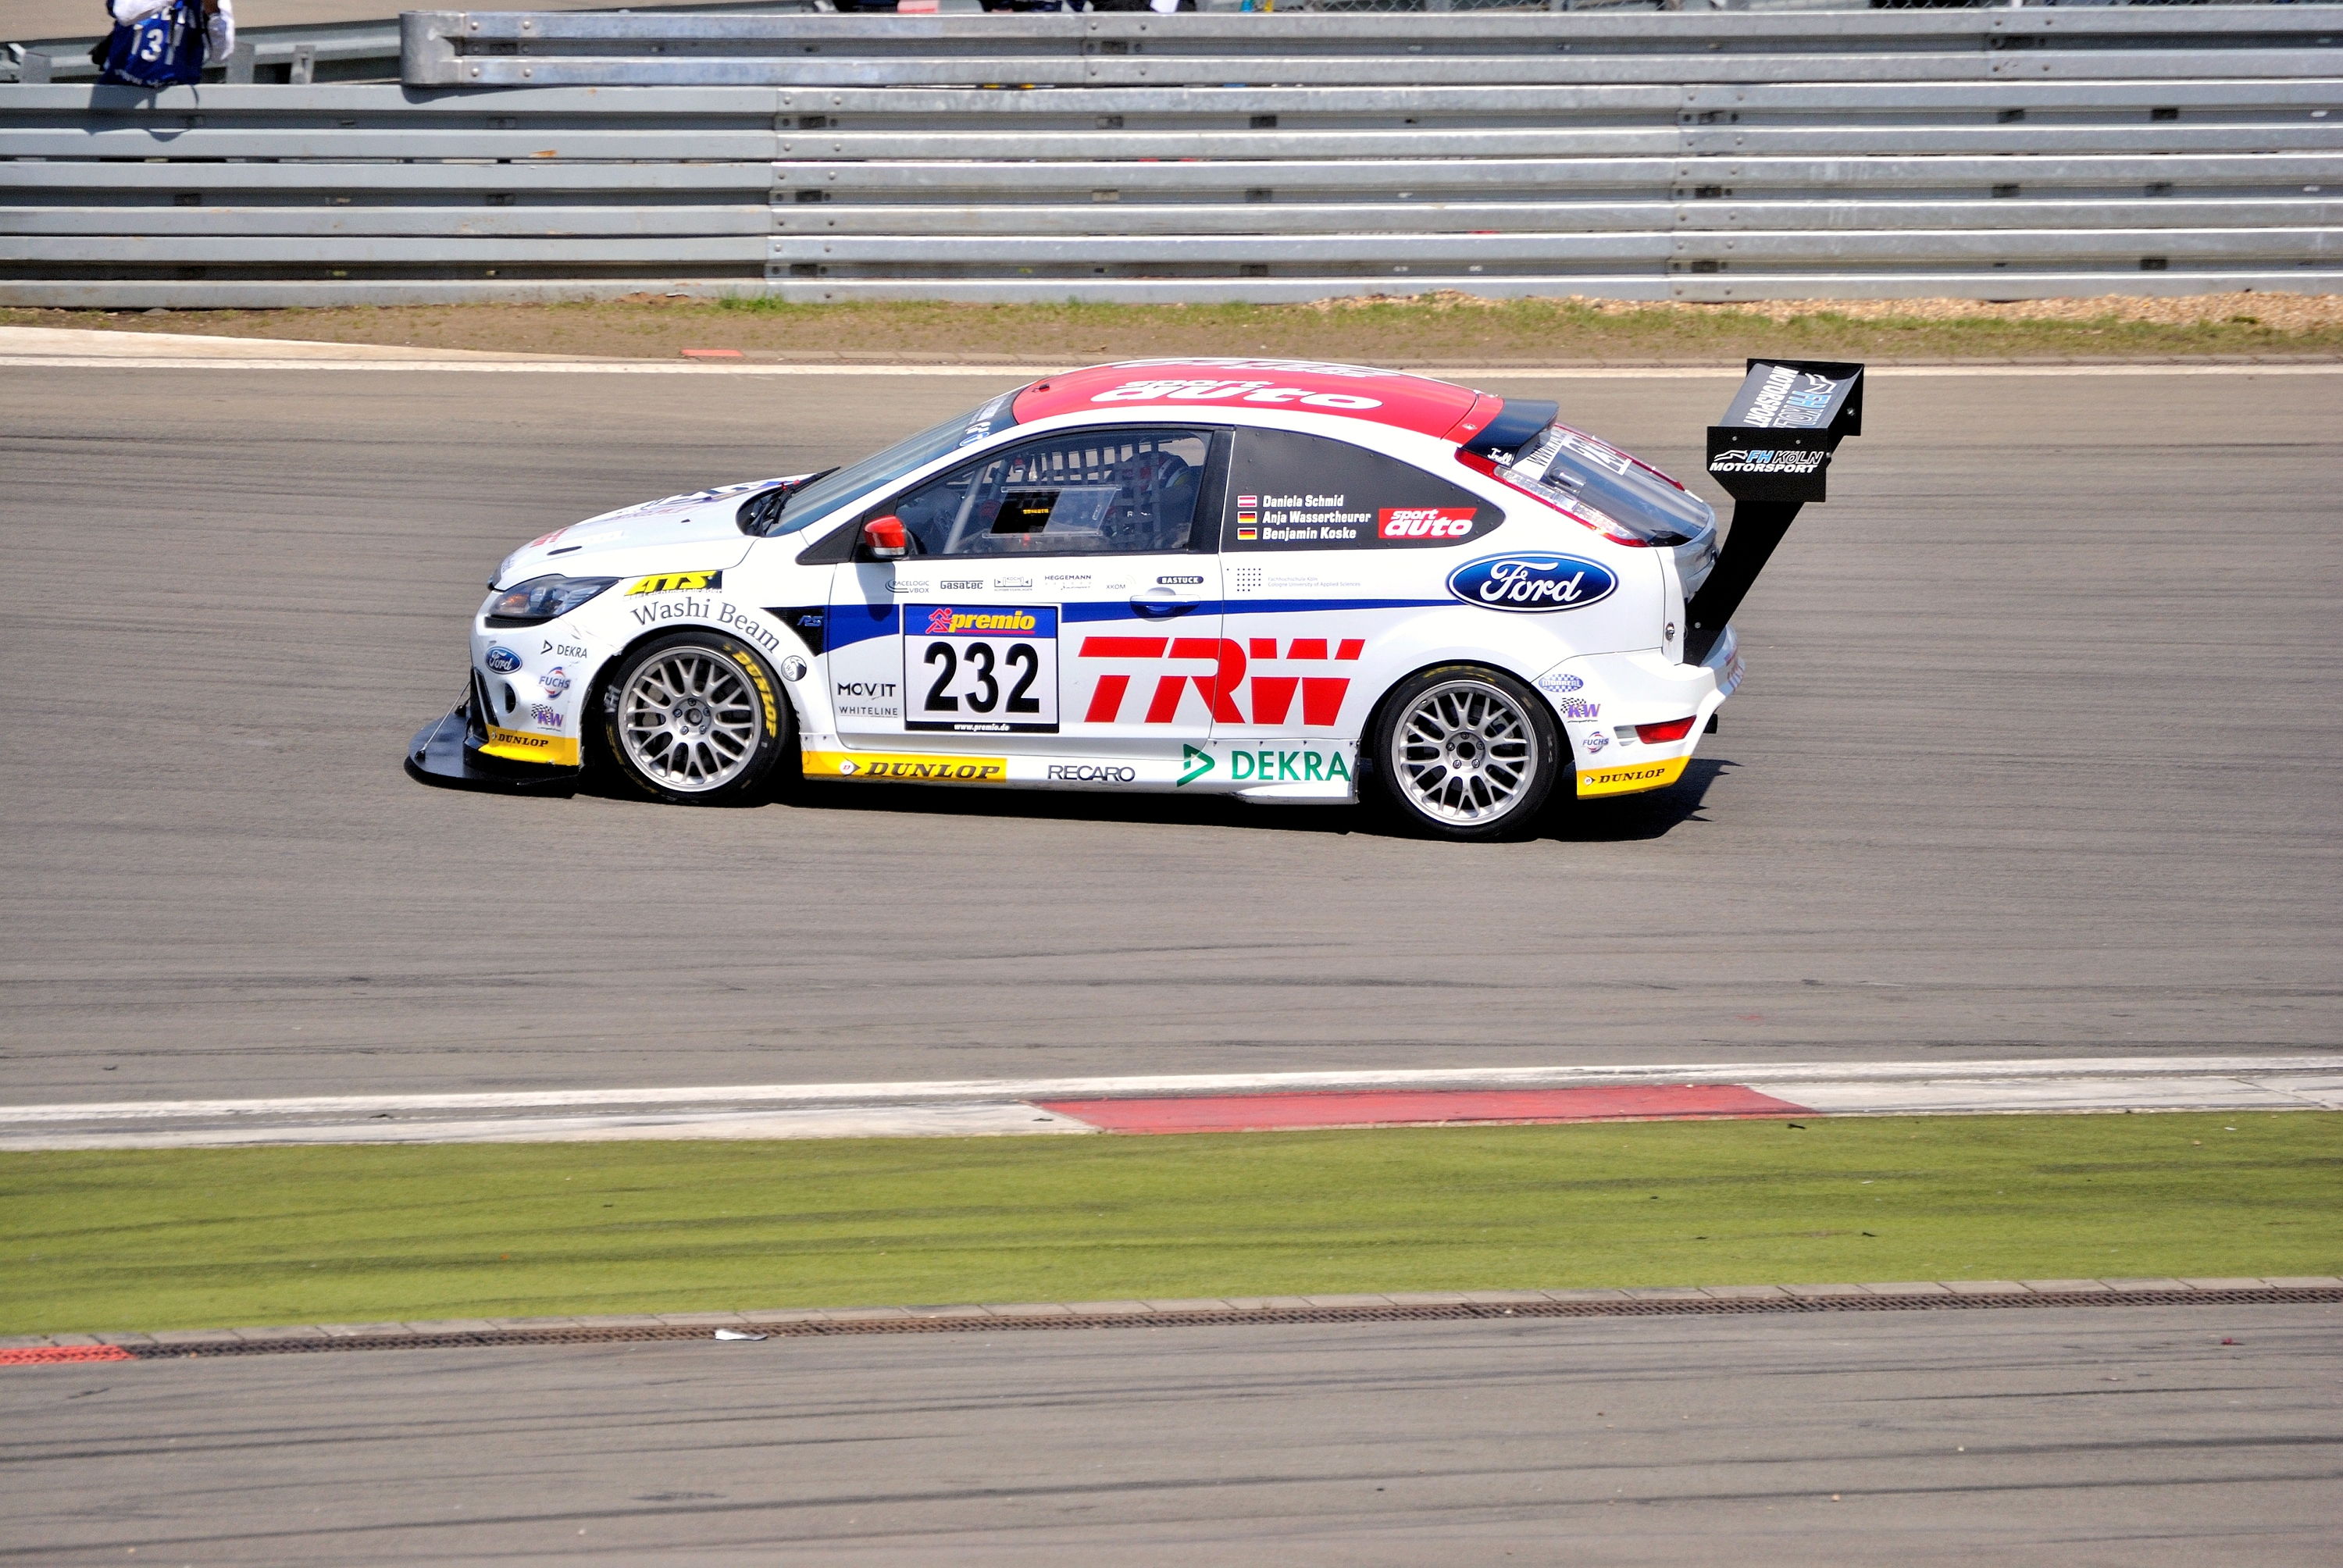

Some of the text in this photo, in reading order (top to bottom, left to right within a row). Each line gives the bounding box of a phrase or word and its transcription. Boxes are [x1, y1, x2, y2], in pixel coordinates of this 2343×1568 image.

[1116, 380, 1275, 390] sport
[1090, 387, 1383, 410] auto
[1743, 365, 1799, 428] MOTORSPORT
[1786, 390, 1833, 409] FH
[1746, 450, 1774, 463] FH
[1709, 462, 1819, 473] MOTORSPORT
[1262, 495, 1344, 508] Daniela Schmid
[1262, 511, 1371, 526] Anja Wassertheurer
[1391, 508, 1439, 521] sport
[1384, 516, 1473, 536] auto
[1263, 527, 1357, 542] Benjamin Koske
[624, 570, 717, 596] ATS
[1479, 560, 1585, 602] Ford
[629, 597, 780, 654] Washi Beam
[797, 615, 823, 626] RS
[948, 611, 1036, 633] premio
[557, 644, 587, 658] DEKRA
[489, 650, 512, 671] Ford
[538, 675, 572, 689] FUCHS
[923, 641, 1040, 714] 232
[1078, 636, 1366, 727] TRW
[537, 710, 564, 727] KW
[839, 706, 898, 716] WHITELINE
[1567, 703, 1601, 718] KW
[954, 723, 1010, 732] www.premio.de
[497, 733, 549, 747] DUNLOP
[865, 761, 1000, 779] DUNLOP
[1047, 765, 1136, 782] RECARO
[1232, 750, 1351, 782] DEKRA
[1598, 768, 1665, 783] DUNLOP
